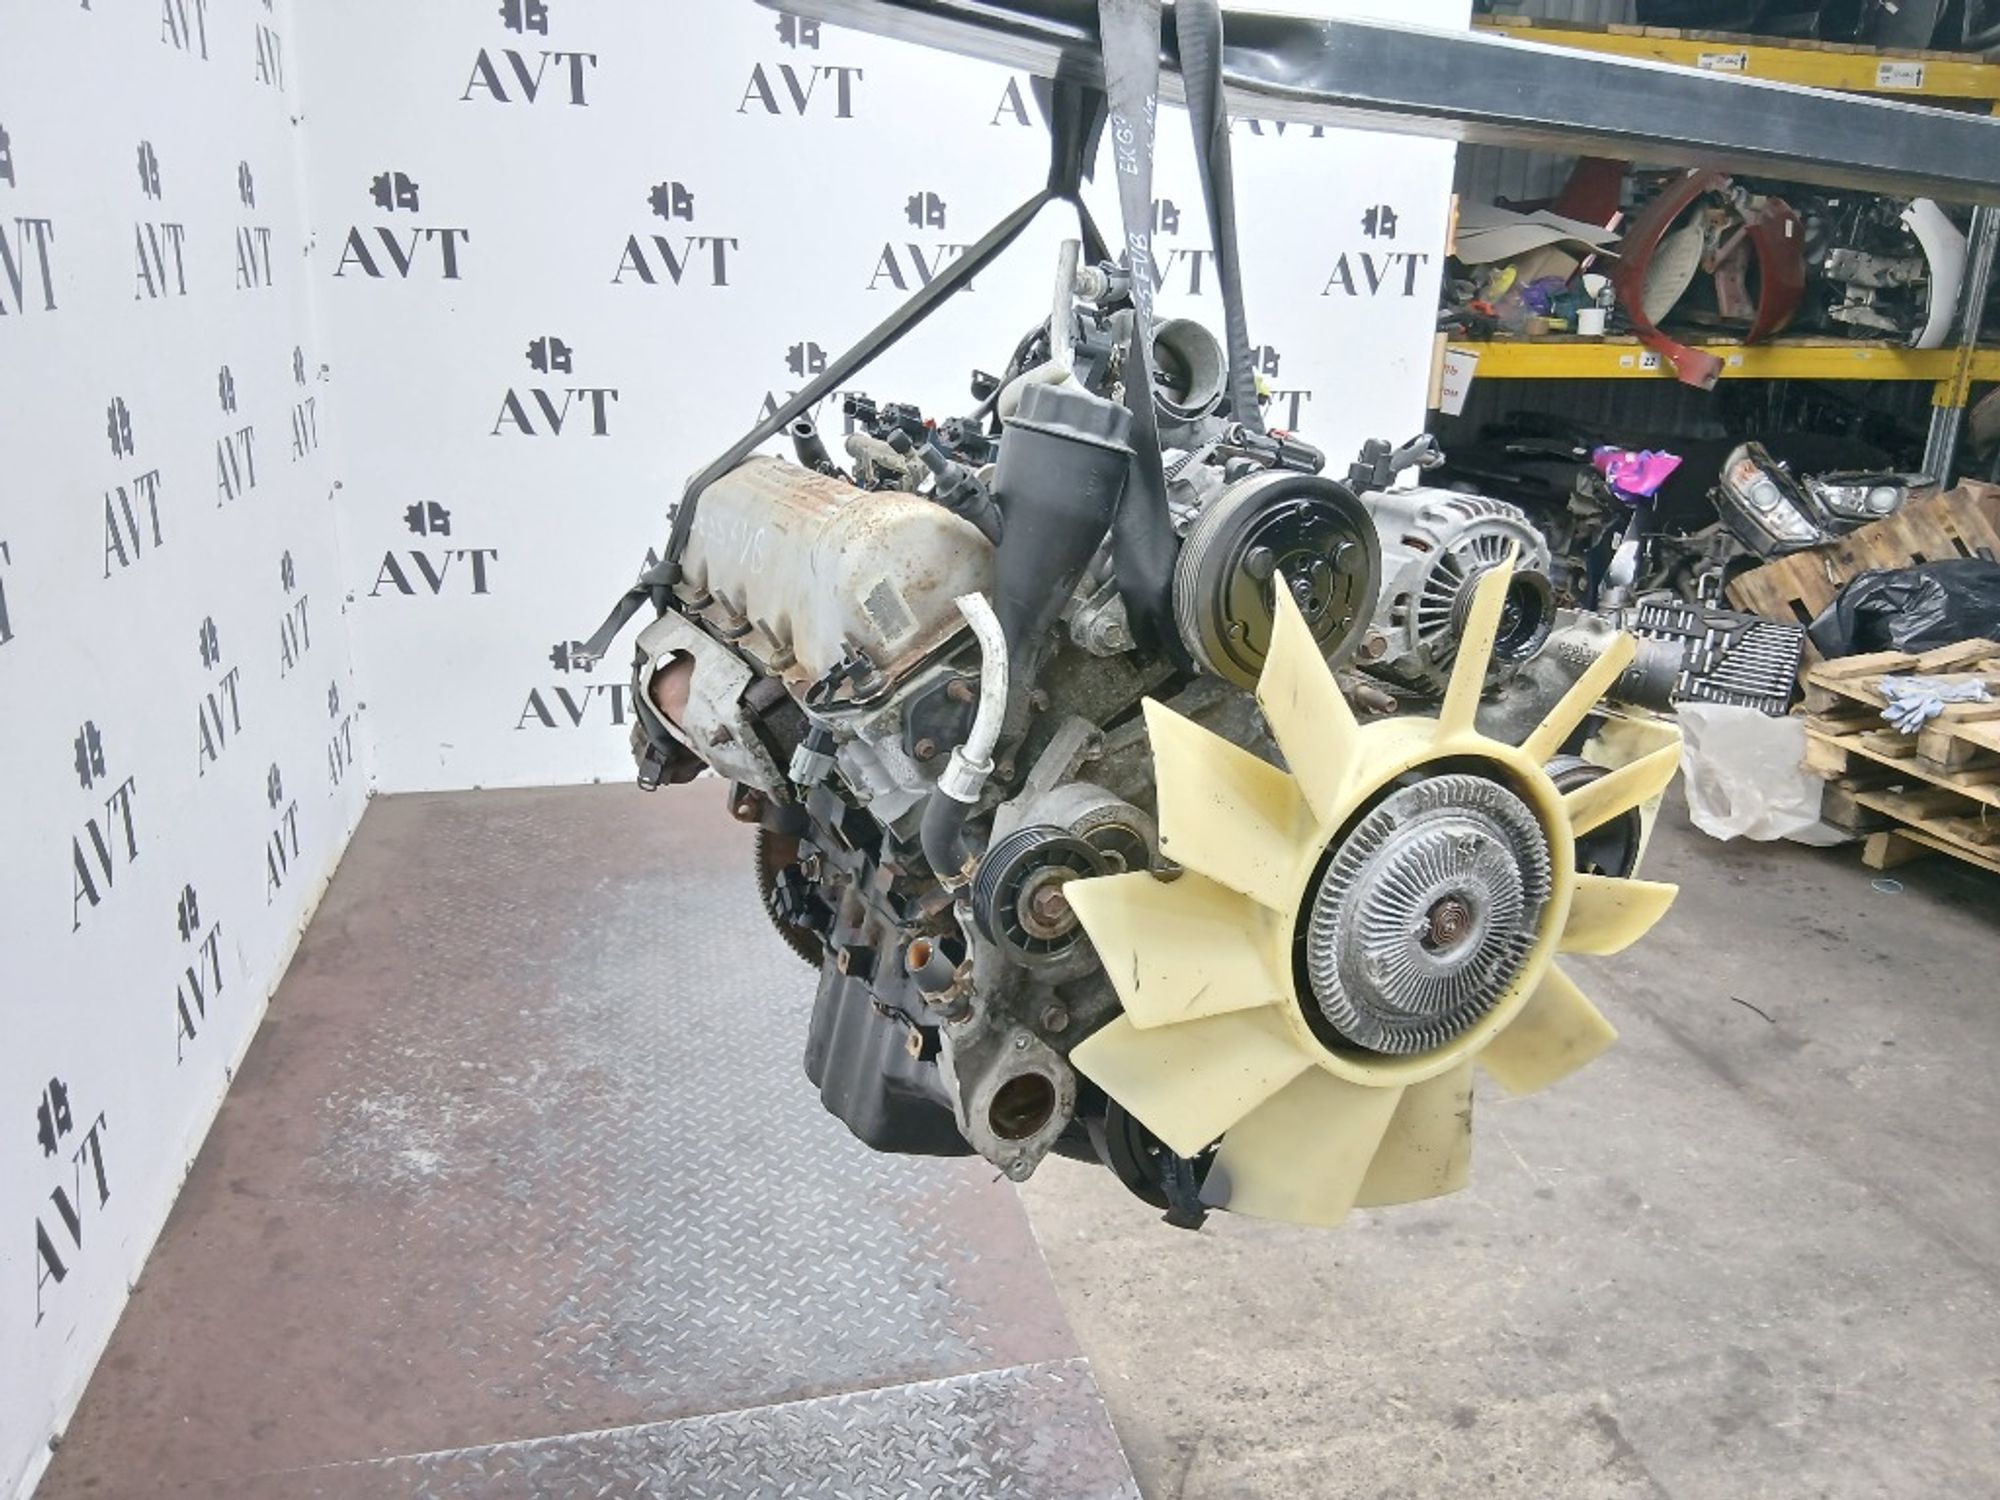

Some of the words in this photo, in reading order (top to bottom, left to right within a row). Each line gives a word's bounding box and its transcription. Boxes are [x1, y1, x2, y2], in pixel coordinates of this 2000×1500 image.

[255, 23, 284, 92] AVT
[459, 47, 597, 106] AVT
[736, 62, 863, 118] AVT
[0, 217, 58, 315] VT
[135, 222, 187, 301] AVT
[236, 226, 272, 290] AVT
[332, 225, 470, 280] AVT
[610, 234, 739, 286] AVT
[1320, 252, 1429, 297] AVT
[292, 396, 317, 462] AVT
[489, 388, 618, 436] AVT
[217, 426, 256, 508] AVT
[104, 469, 163, 579] AVT
[367, 549, 498, 597] AVT
[280, 594, 310, 679] AVT
[199, 666, 241, 777] AVT
[513, 684, 632, 730] AVT
[328, 712, 352, 797] AVT
[72, 774, 139, 933] AVT
[267, 798, 300, 906] AVT
[177, 919, 223, 1065] AVT
[35, 1109, 110, 1328] AVT
